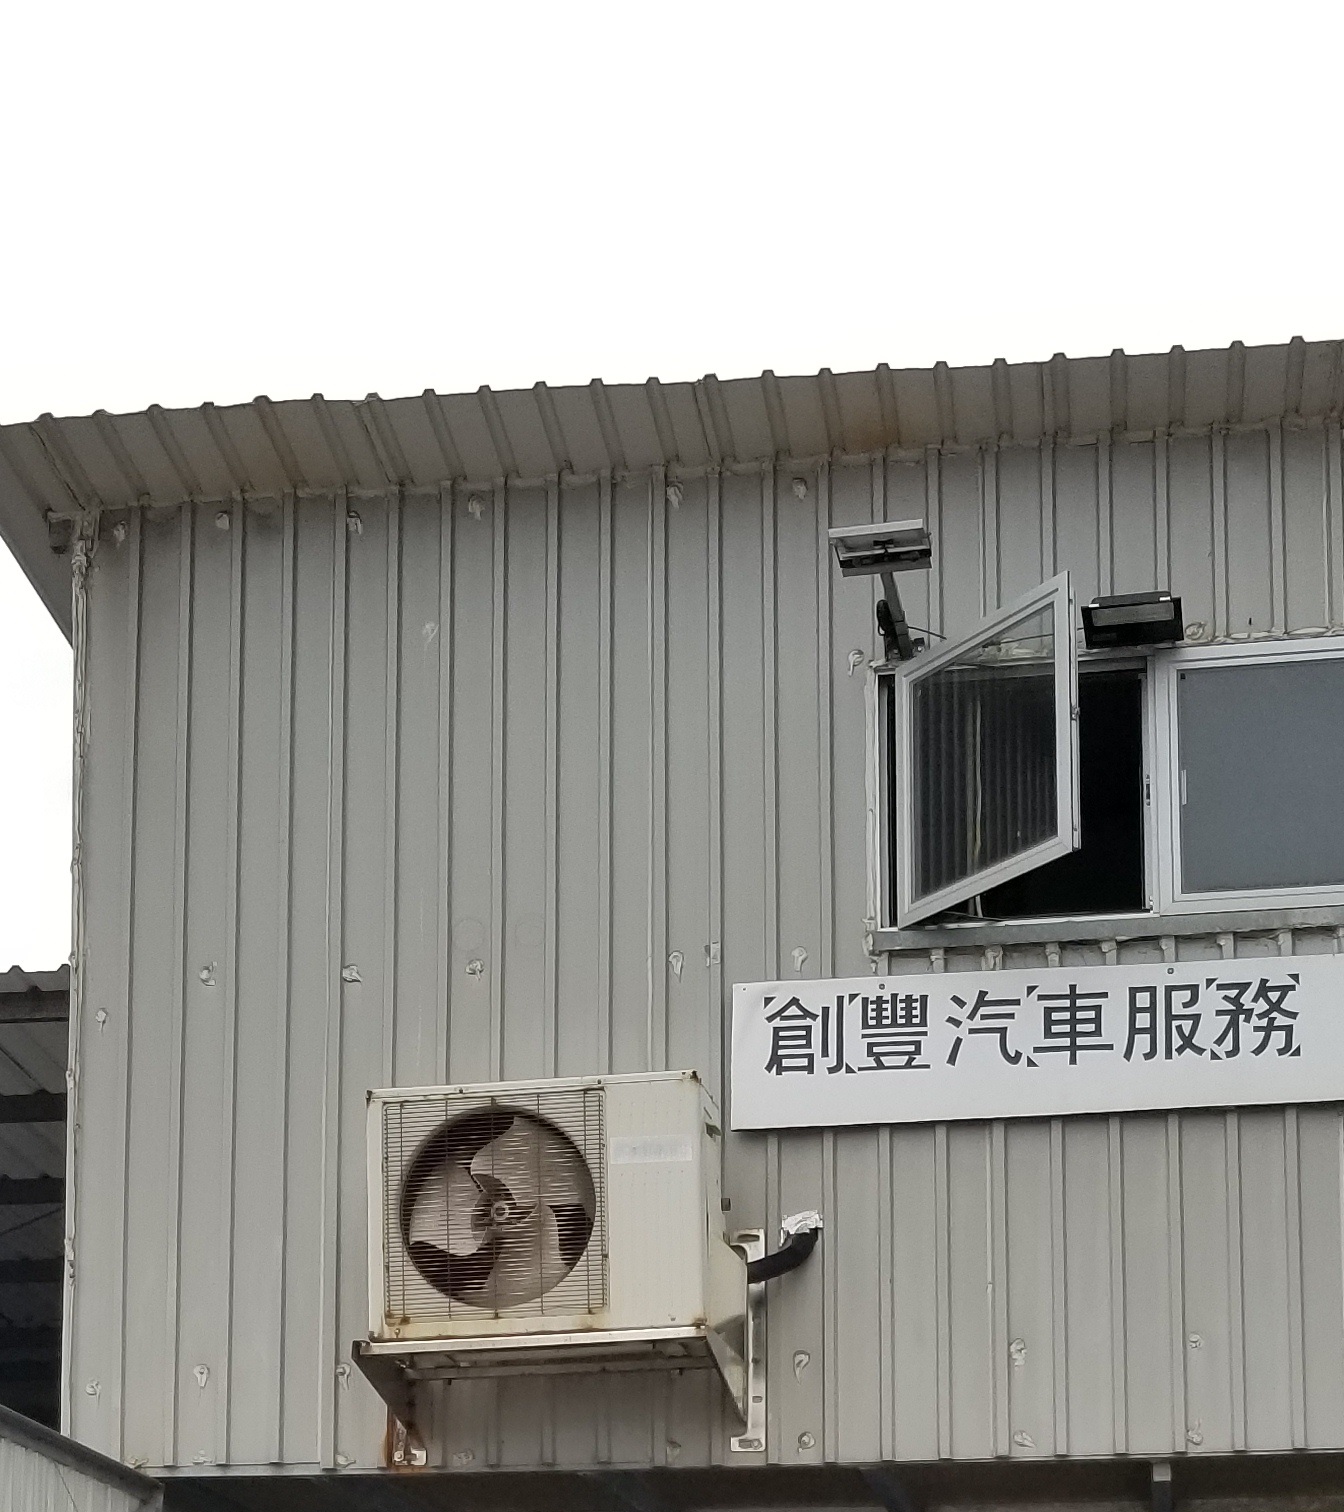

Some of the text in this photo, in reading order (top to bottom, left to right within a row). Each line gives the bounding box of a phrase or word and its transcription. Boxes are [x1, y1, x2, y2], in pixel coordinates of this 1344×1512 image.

[763, 975, 1301, 1075] 創豐汽車服務
